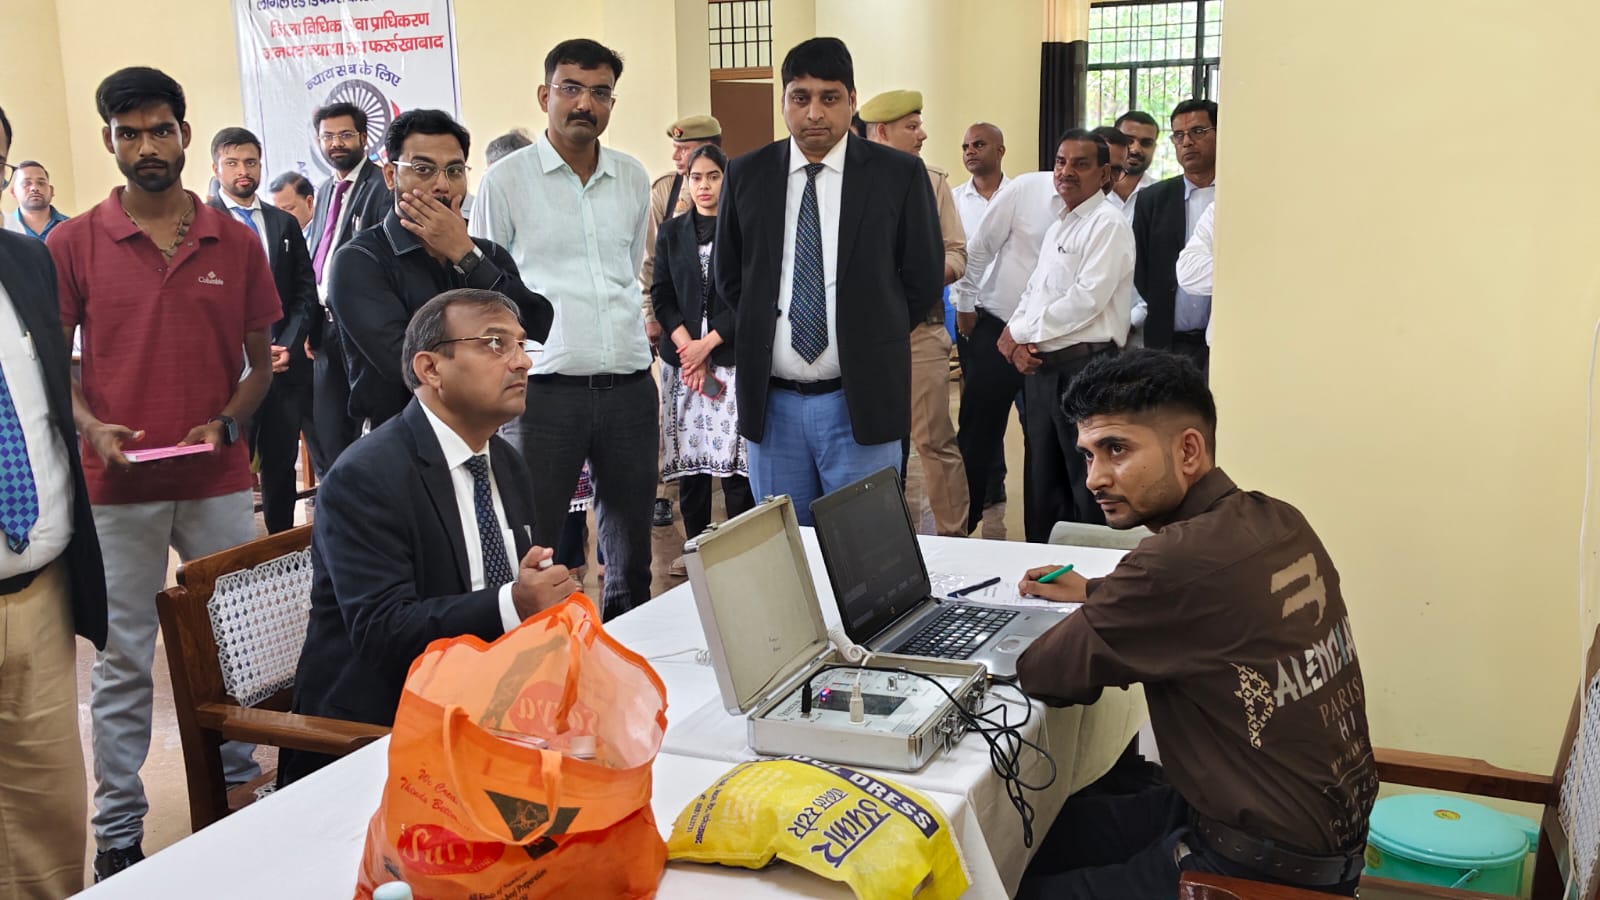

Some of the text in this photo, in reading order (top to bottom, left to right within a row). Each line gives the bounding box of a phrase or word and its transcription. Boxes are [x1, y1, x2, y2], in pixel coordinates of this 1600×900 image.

[370, 10, 429, 32] प्राधिकरण
[375, 63, 402, 87] लिए
[1319, 677, 1362, 728] PARIS
[850, 773, 932, 829] DRESS
[811, 798, 891, 869] उपकार
